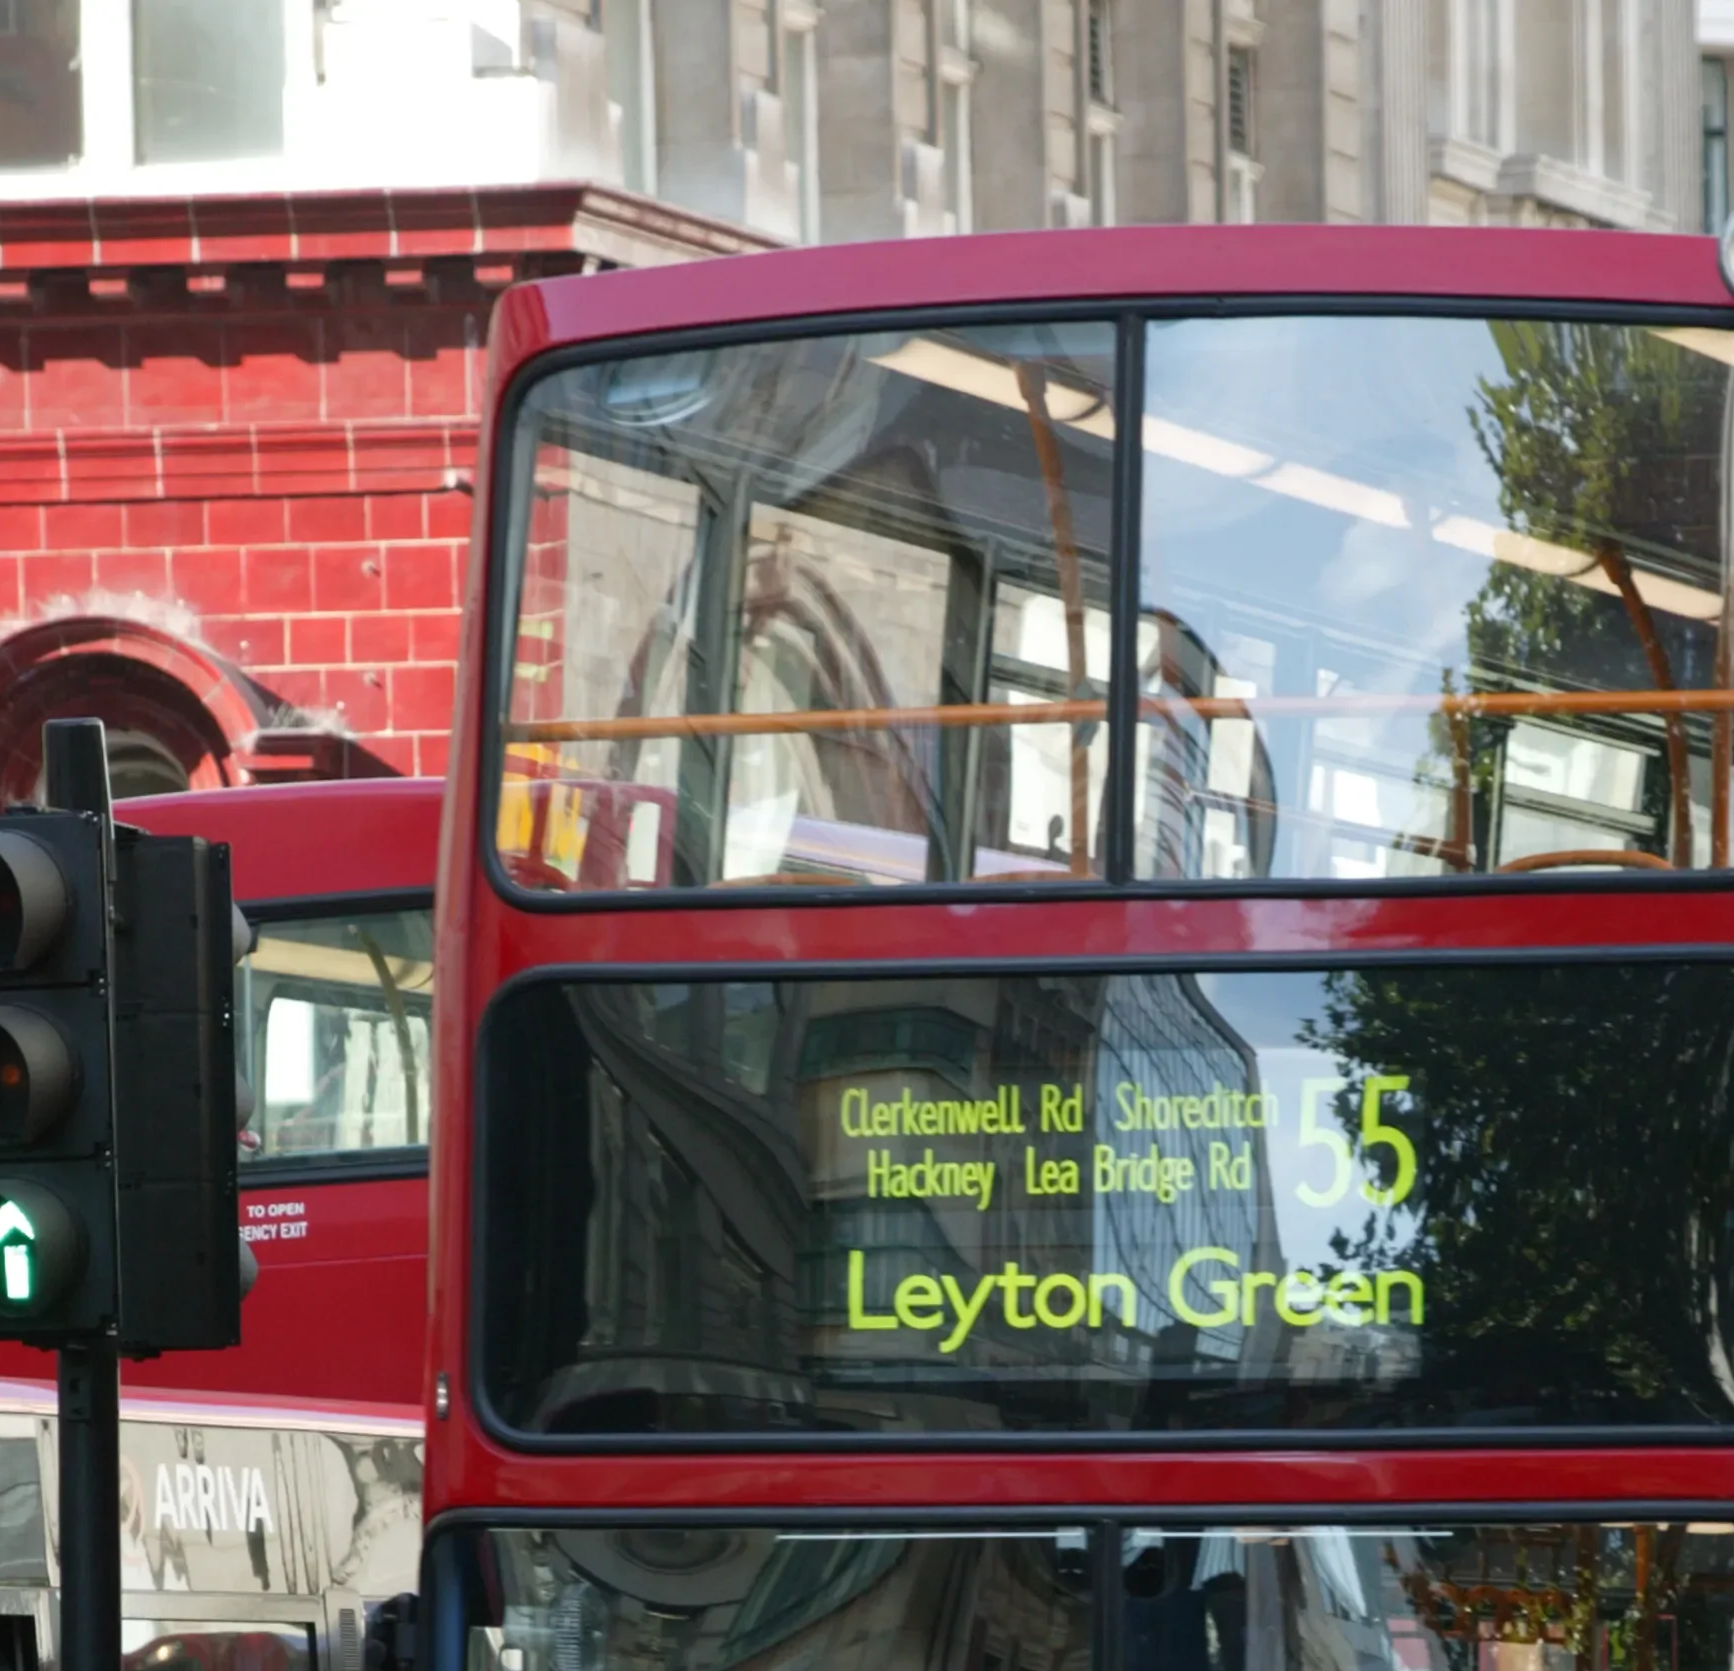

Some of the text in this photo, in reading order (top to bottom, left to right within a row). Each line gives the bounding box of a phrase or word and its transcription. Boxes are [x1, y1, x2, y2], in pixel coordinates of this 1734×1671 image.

[841, 1080, 1280, 1137] Clerkenwell Rd Shoreditch
[1295, 1074, 1420, 1209] 55
[246, 1202, 305, 1218] TO OPEN
[867, 1140, 1252, 1211] Hackney Lea Bridge Rd
[280, 1221, 309, 1238] EXIT
[848, 1245, 1426, 1355] Leyton Green
[153, 1462, 275, 1534] ARRIVA
